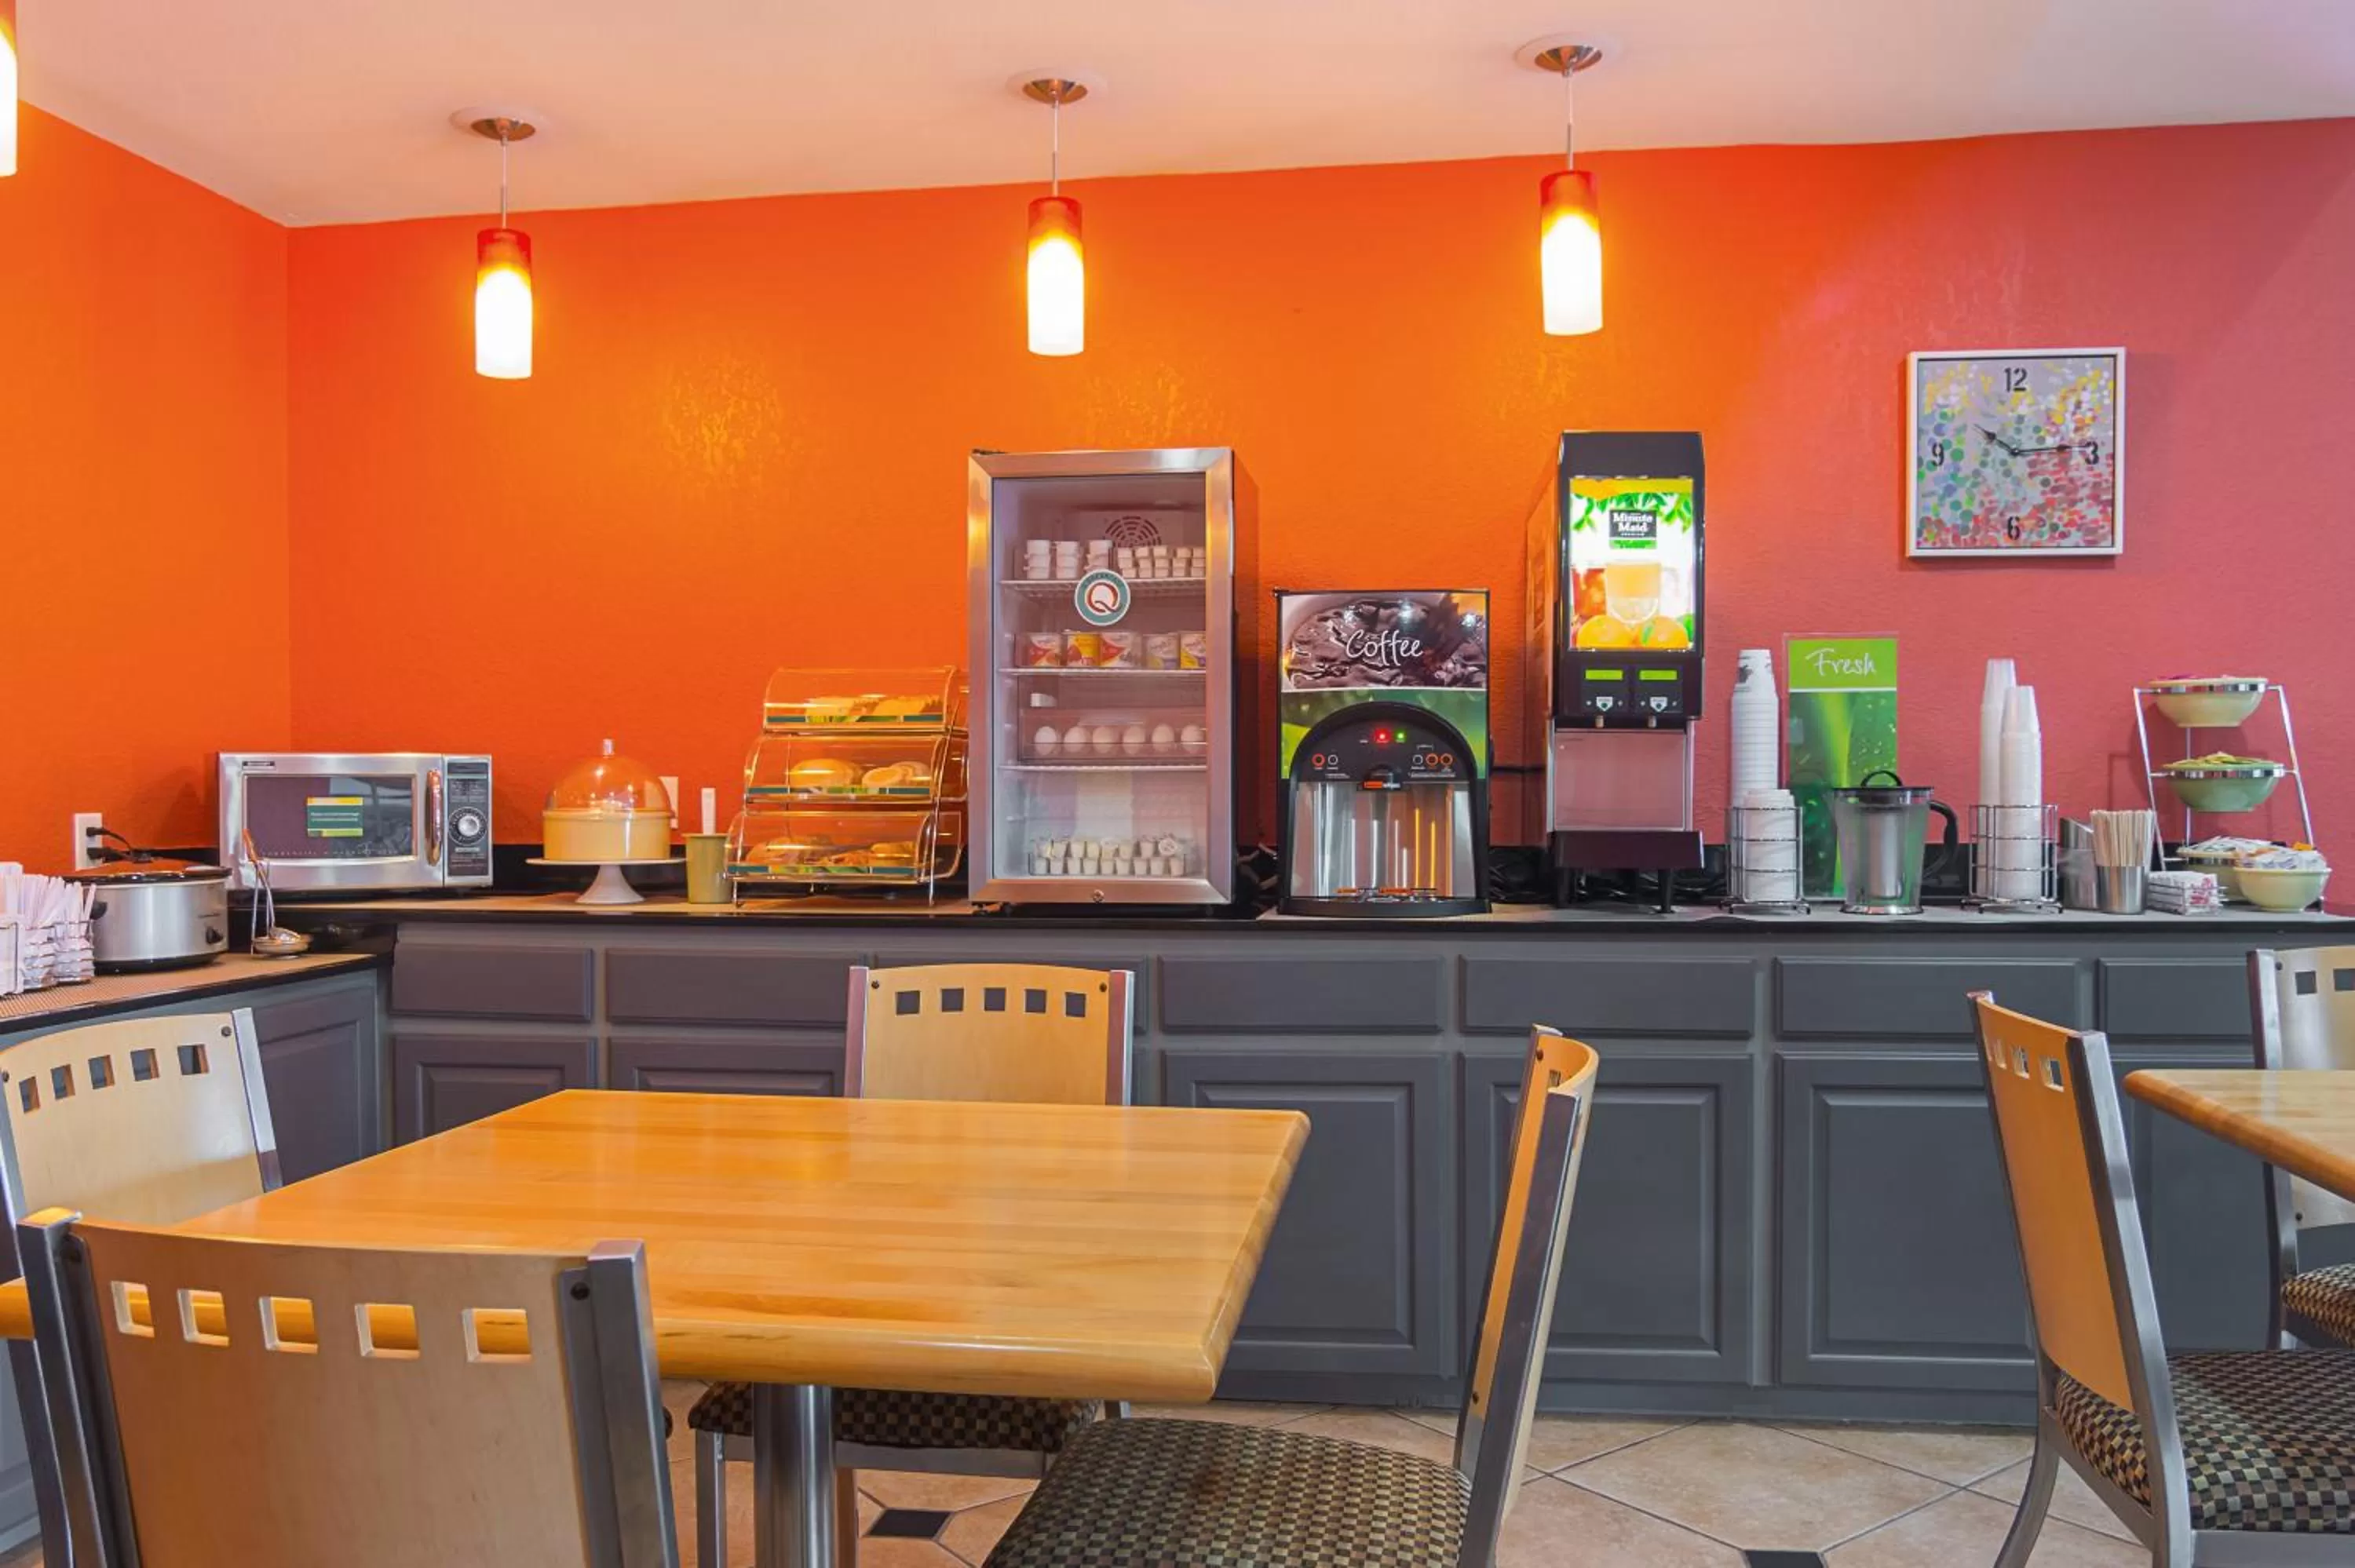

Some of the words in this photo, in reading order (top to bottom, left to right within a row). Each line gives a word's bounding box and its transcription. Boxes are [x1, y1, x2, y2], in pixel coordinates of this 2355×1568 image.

[2004, 367, 2028, 392] 12
[1932, 443, 1944, 466] 9
[2085, 441, 2099, 465] 3
[1613, 512, 1652, 523] Minute
[1618, 522, 1648, 532] Maid
[2006, 516, 2021, 540] 6
[1346, 629, 1423, 666] Coffee
[1806, 647, 1876, 676] Fresh
